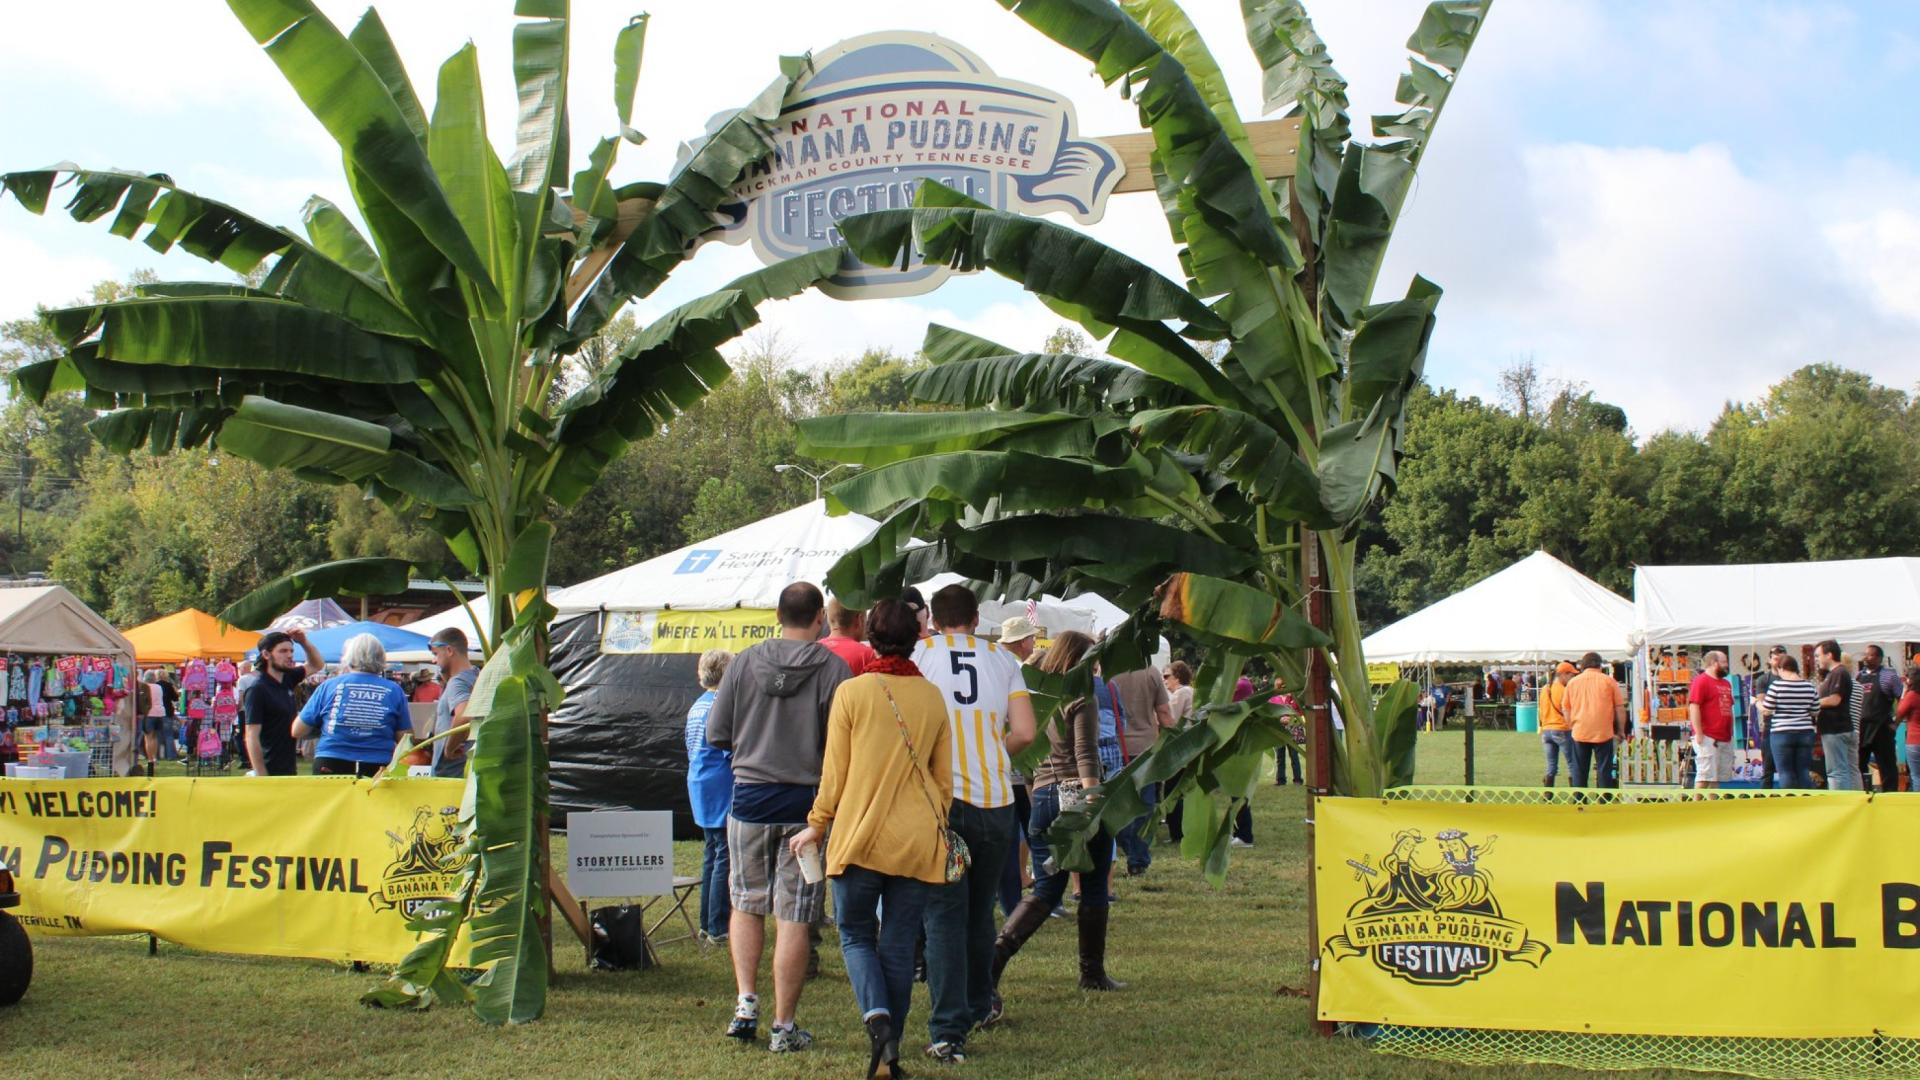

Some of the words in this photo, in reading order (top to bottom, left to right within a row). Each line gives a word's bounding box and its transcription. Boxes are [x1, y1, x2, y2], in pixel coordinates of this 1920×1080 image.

[791, 100, 974, 135] NATIONAL
[886, 118, 1039, 157] PUDDING
[734, 167, 817, 198] HICKMAN
[828, 154, 903, 172] COUNTY
[915, 152, 1031, 169] TENNESSEE
[783, 547, 849, 558] Thoma
[657, 622, 700, 640] WHERE
[703, 620, 737, 639] YA'LL
[950, 651, 978, 704] 5
[348, 690, 386, 701] STAFF
[24, 790, 157, 818] WELCOME!
[34, 835, 187, 886] PUDDING
[200, 841, 368, 893] FESTIVAL
[576, 855, 664, 867] STORYTELLERS
[388, 881, 438, 896] BANANA
[1388, 914, 1480, 925] NATIONAL
[1555, 881, 1857, 949] NATIONAL
[1355, 922, 1429, 939] BANANA
[1437, 922, 1514, 945] PUDDING
[1382, 945, 1486, 973] FESTIVAL
